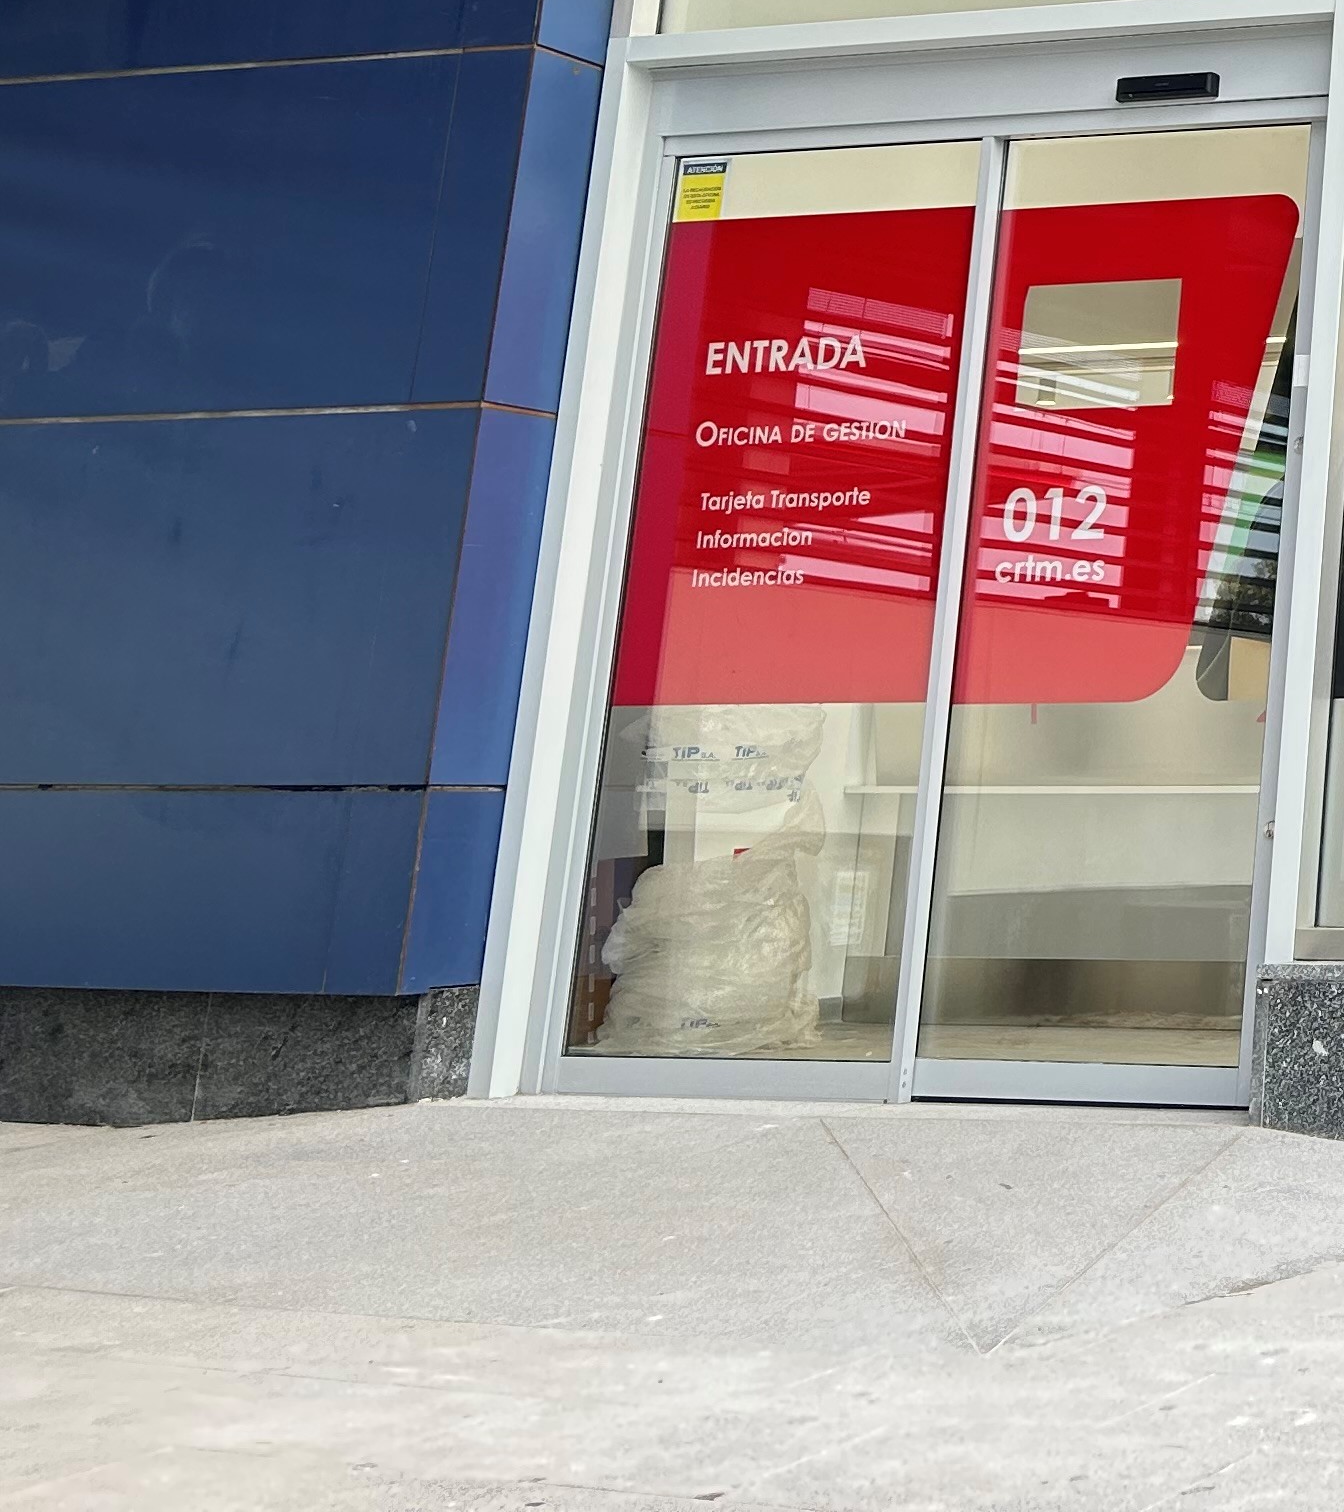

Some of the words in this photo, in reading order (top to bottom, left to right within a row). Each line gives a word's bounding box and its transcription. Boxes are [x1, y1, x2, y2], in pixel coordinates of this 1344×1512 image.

[705, 334, 866, 375] ENTRADA
[696, 420, 782, 447] OFICINA
[790, 424, 815, 443] DE
[701, 491, 765, 514] Tarjeta
[770, 487, 871, 511] Transporte
[1003, 485, 1107, 542] 012
[691, 565, 805, 587] Incidencias
[995, 555, 1105, 583] crtm.es
[672, 746, 700, 759] TIP
